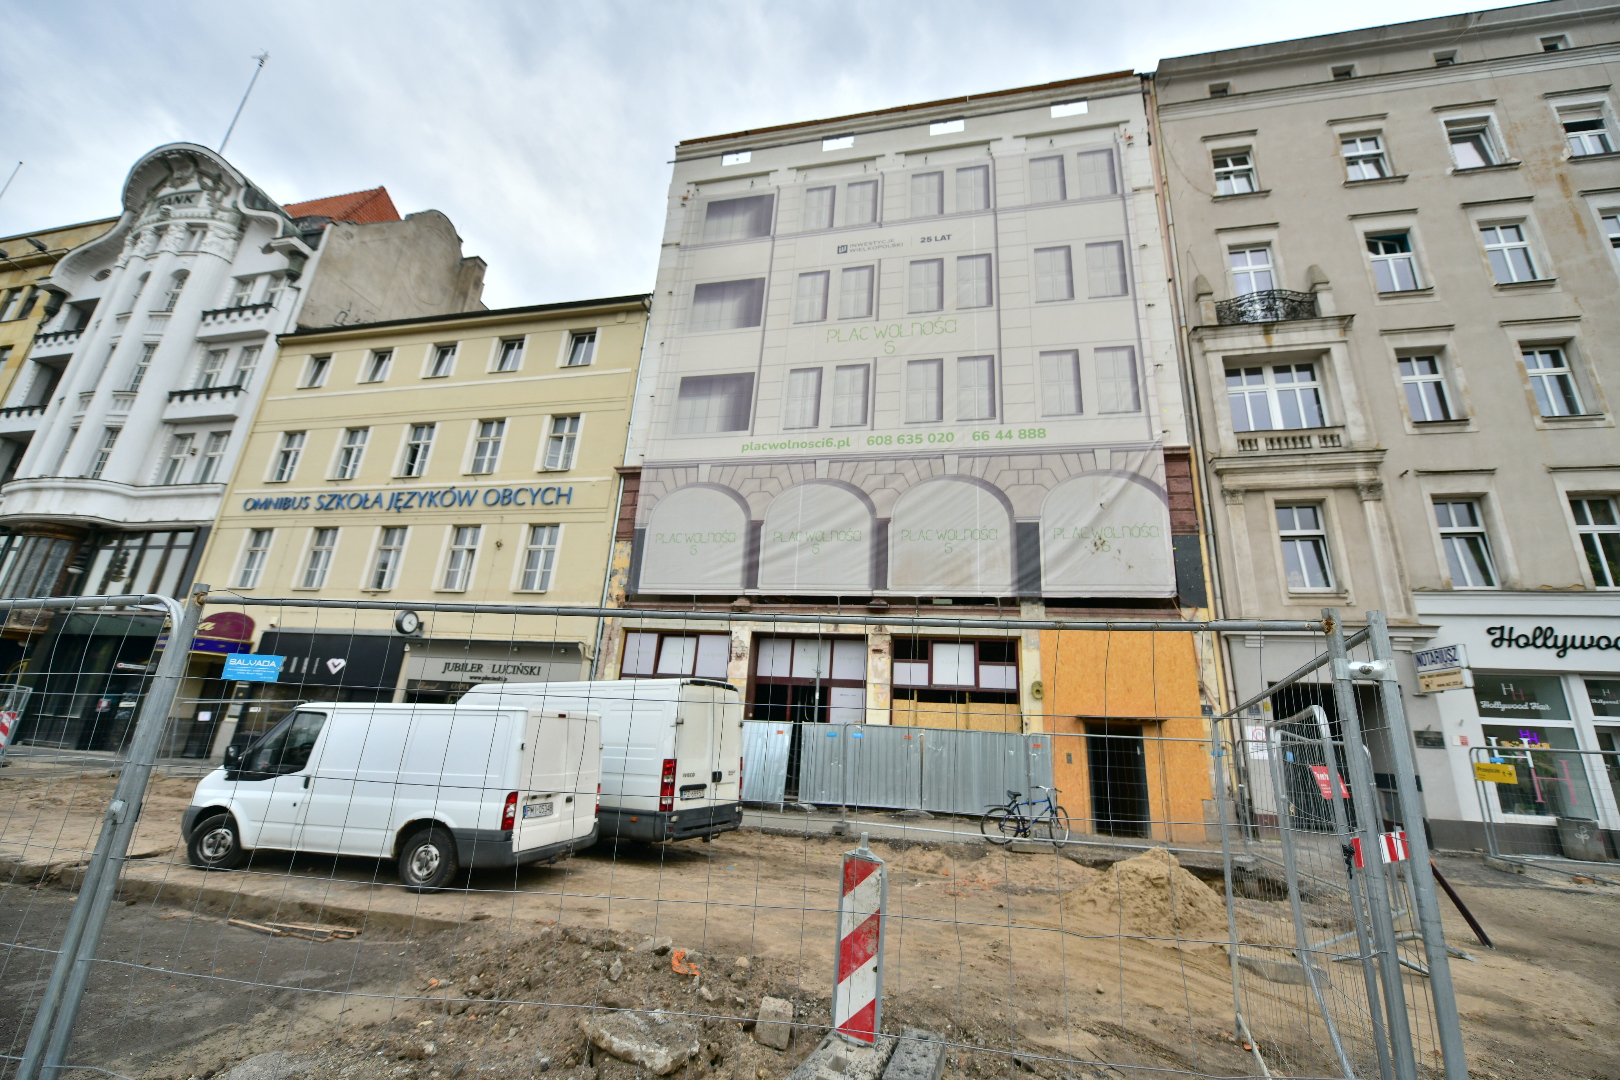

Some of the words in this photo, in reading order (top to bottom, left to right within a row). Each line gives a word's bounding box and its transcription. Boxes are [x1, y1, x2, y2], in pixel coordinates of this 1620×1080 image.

[849, 238, 895, 248] INWESTYCJE
[934, 234, 952, 242] LAT
[849, 242, 904, 253] WIELKOPOLSKI
[827, 326, 869, 343] PLAC
[873, 317, 957, 339] WOLNOŚCI
[884, 340, 896, 354] 6
[741, 437, 851, 453] placwolnosci6.pl
[866, 434, 893, 446] 608
[896, 433, 923, 445] 635
[927, 432, 955, 444] 020
[971, 430, 990, 442] 66
[995, 429, 1014, 441] 44
[1017, 428, 1047, 440] 888
[243, 496, 310, 512] OMNIBUS
[313, 492, 383, 511] SZKOŁA
[386, 486, 478, 513] JĘZYKÓW
[482, 486, 574, 506] OBCYCH
[655, 532, 682, 544] PLAC
[773, 530, 802, 543] PLAC
[901, 529, 933, 541] PLAC
[1053, 526, 1088, 540] PLAC
[229, 658, 276, 668] SALVADA
[1416, 647, 1459, 667] NOTARIUSZ
[442, 661, 484, 674] JUBILER
[491, 662, 542, 676] LUCIŃSKI
[1031, 680, 1044, 700] 6
[1480, 700, 1529, 711] Hollywood
